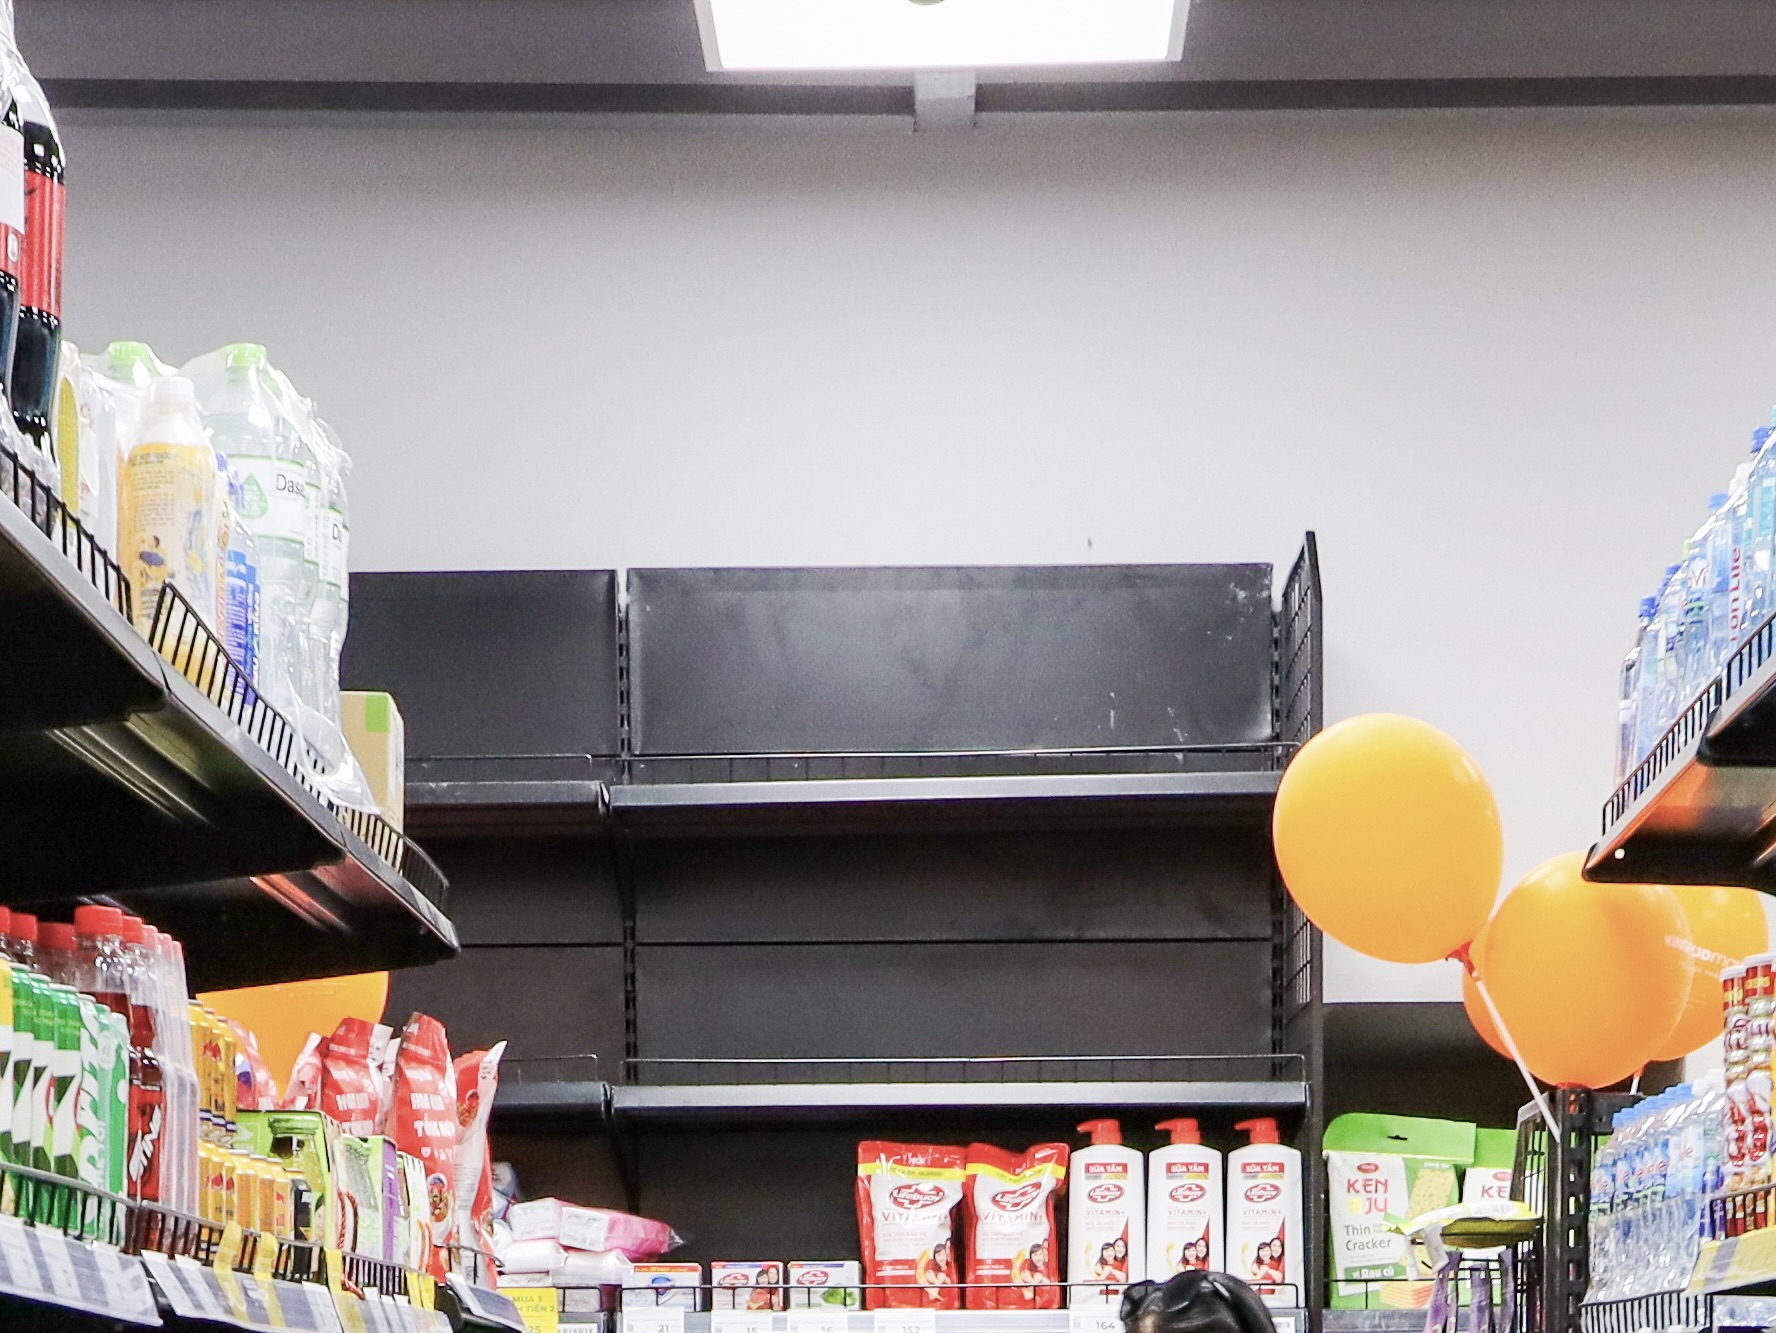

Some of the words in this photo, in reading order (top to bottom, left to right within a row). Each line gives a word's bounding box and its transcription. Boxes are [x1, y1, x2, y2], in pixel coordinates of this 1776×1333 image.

[1347, 1178, 1389, 1194] KEN
[1366, 1198, 1389, 1215] JU
[1344, 1224, 1371, 1237] Thin
[1345, 1237, 1392, 1251] Cracker
[658, 1324, 669, 1333] 21
[902, 1326, 920, 1333] 152
